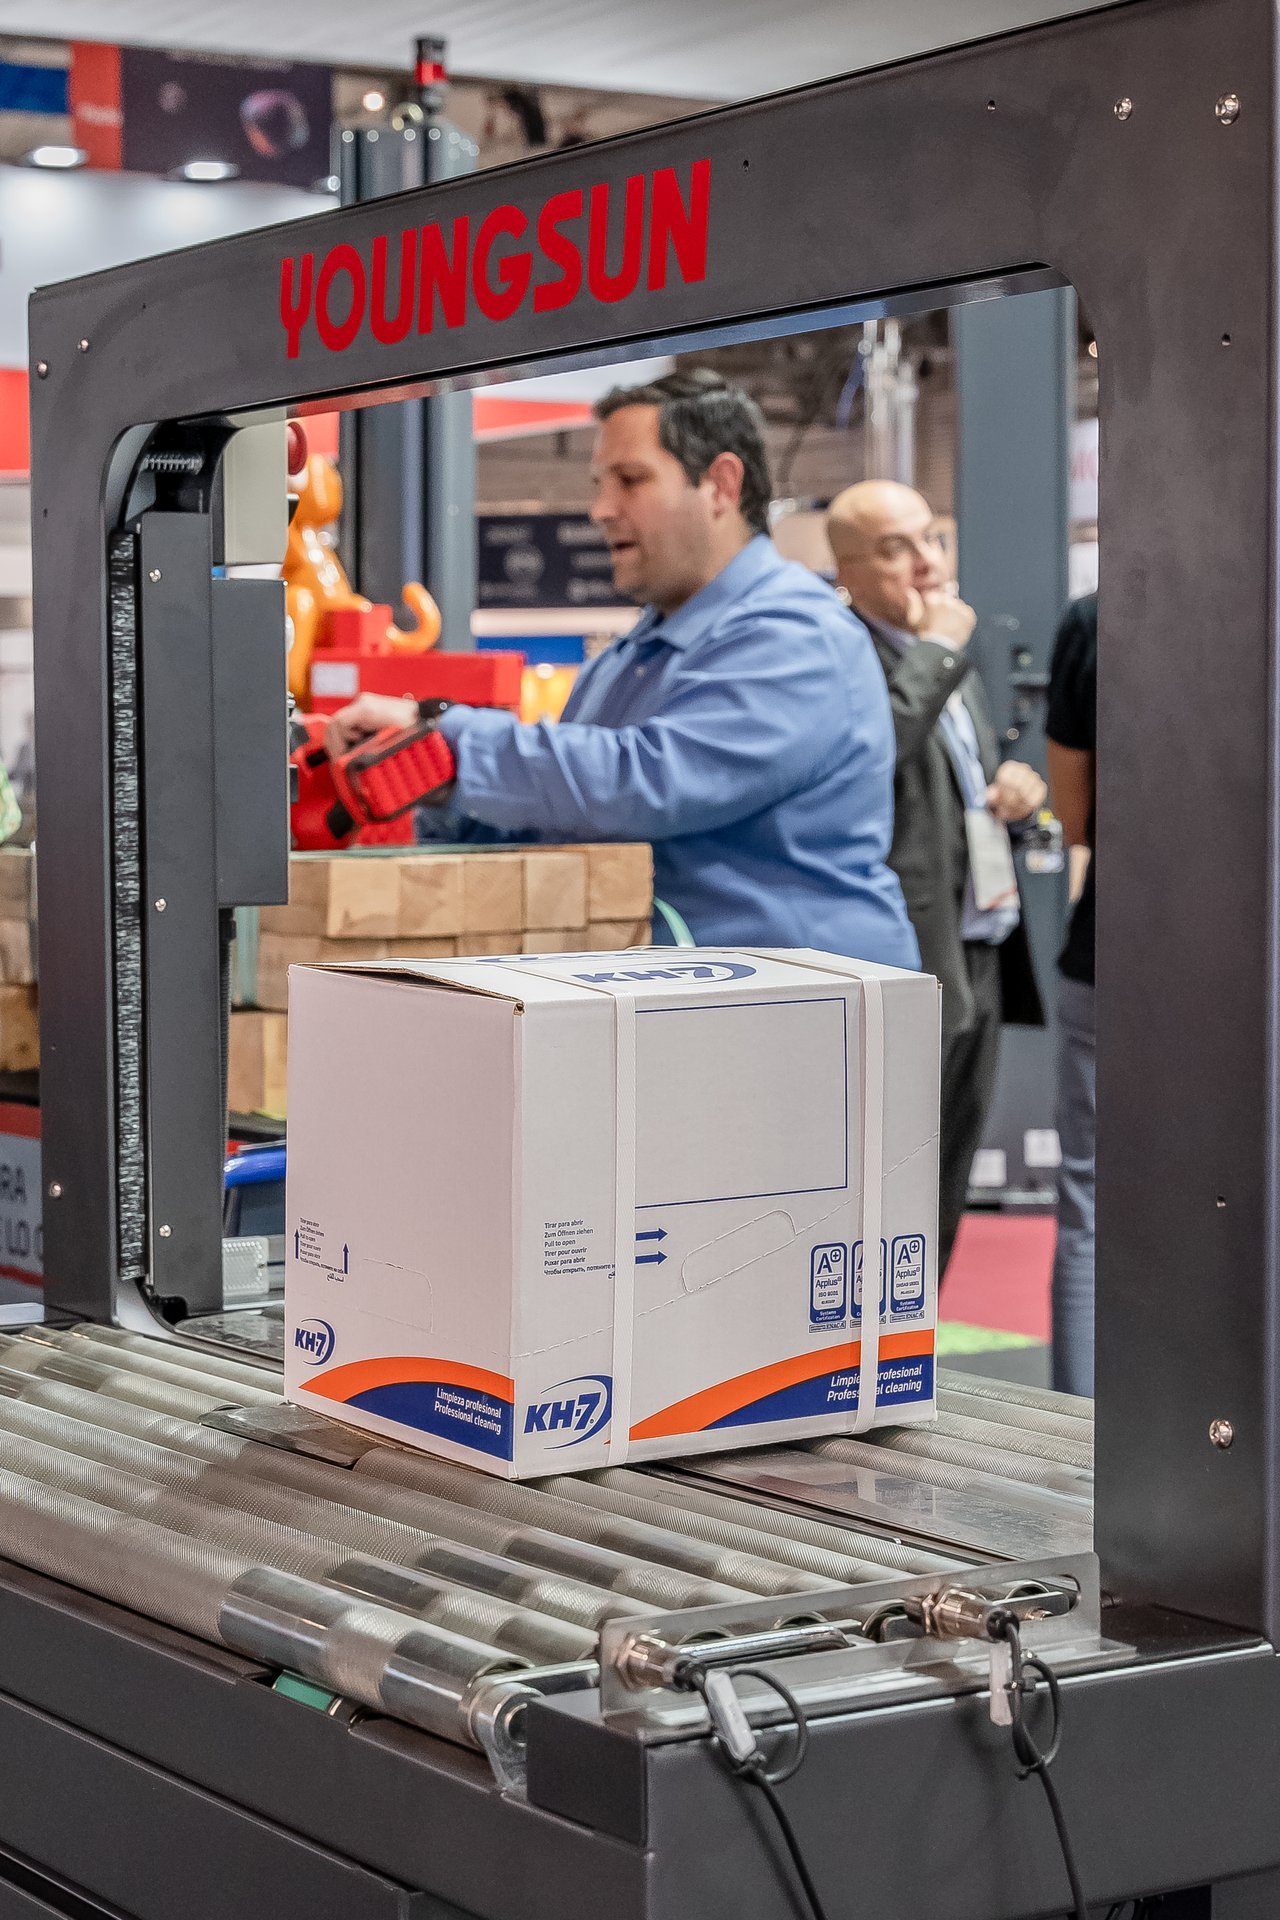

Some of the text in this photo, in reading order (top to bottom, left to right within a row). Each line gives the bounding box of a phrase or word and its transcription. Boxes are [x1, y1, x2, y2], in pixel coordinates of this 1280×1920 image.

[281, 159, 711, 358] YOUNGSUN
[295, 1328, 327, 1357] KH-7
[436, 1387, 502, 1418] Limpieza profesional
[885, 1380, 922, 1394] cleaning
[434, 1401, 502, 1435] Professional cleaning
[524, 1392, 601, 1434] KH-7
